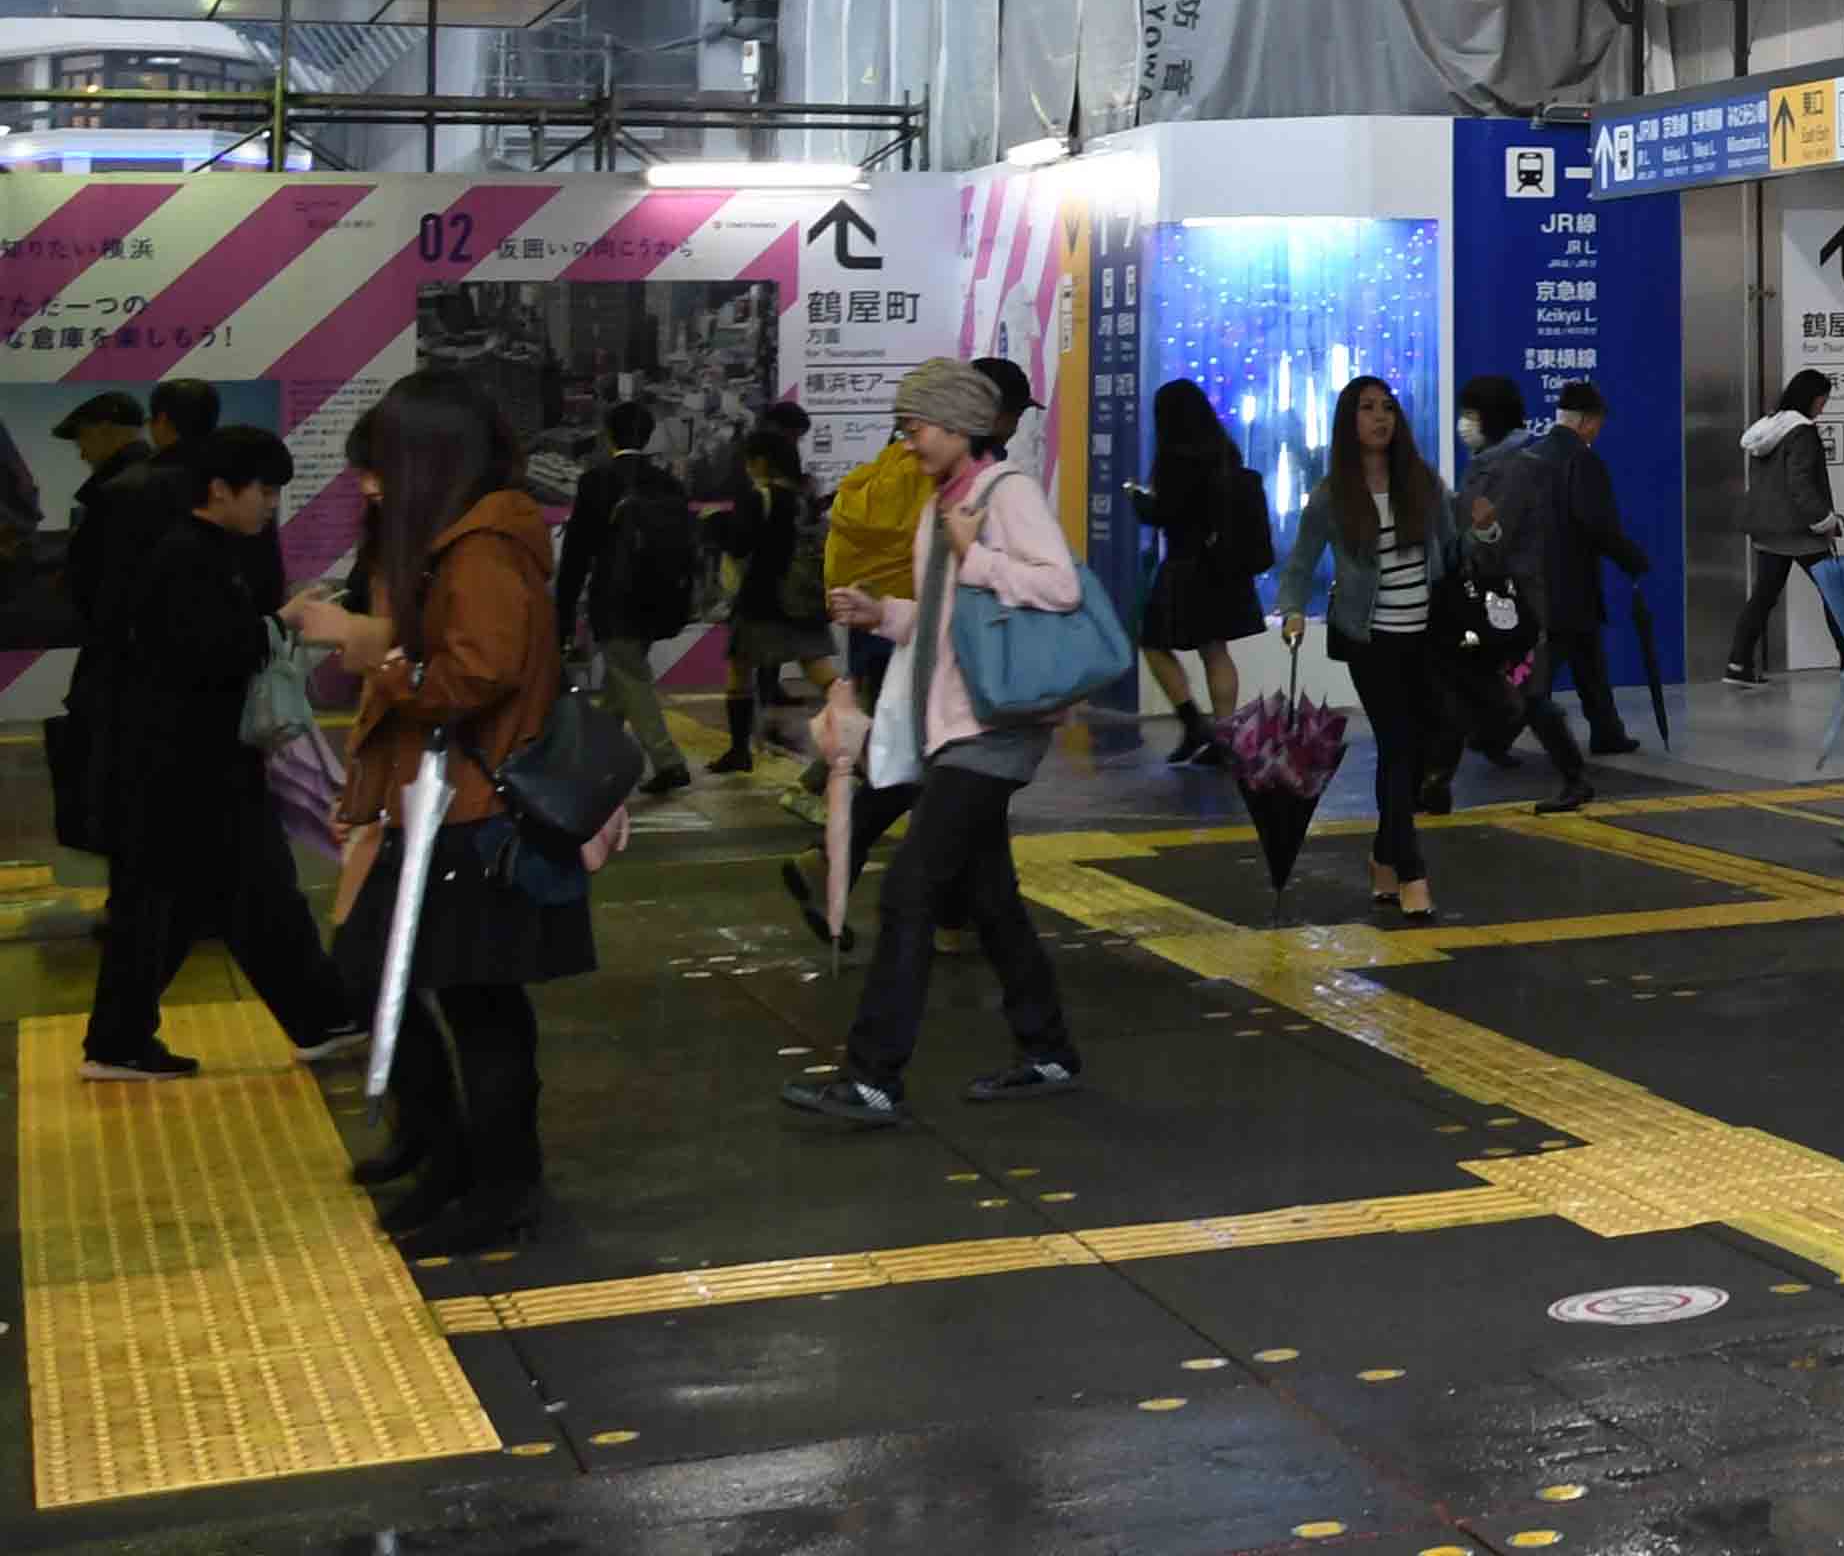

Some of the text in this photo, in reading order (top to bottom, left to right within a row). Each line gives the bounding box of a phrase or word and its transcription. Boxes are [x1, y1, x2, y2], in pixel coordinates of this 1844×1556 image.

[1541, 213, 1597, 233] JR線
[419, 213, 473, 263] 02
[1536, 281, 1597, 302] 京急線
[807, 290, 921, 325] 鶴屋町
